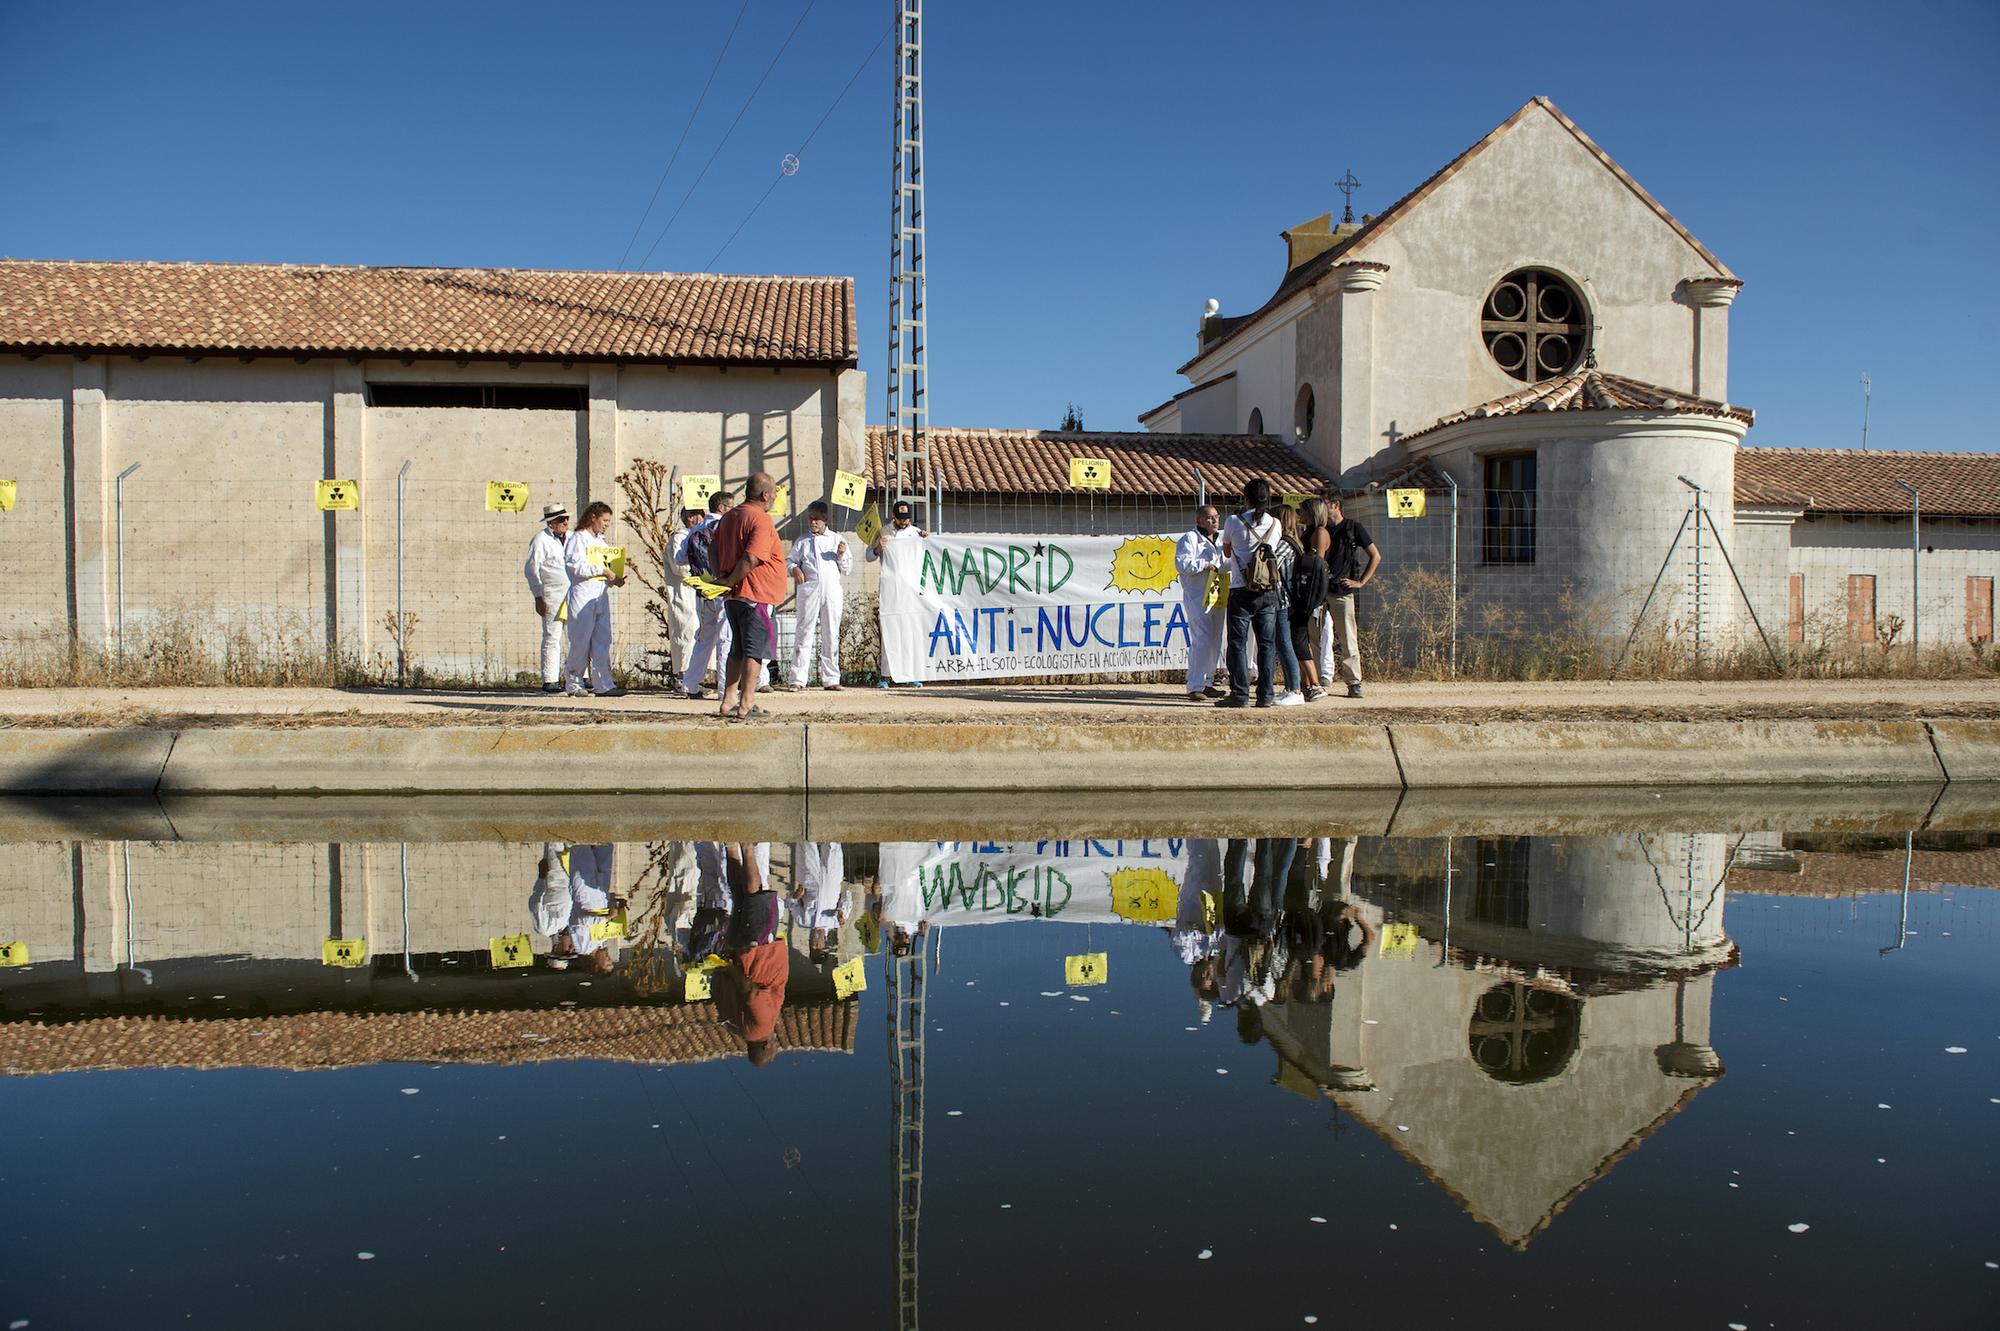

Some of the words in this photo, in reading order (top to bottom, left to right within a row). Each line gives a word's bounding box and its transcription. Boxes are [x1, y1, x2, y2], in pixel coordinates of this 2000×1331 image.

[936, 657, 975, 673] ARBA
[1089, 653, 1100, 669] EN
[1136, 649, 1172, 665] GRAMA
